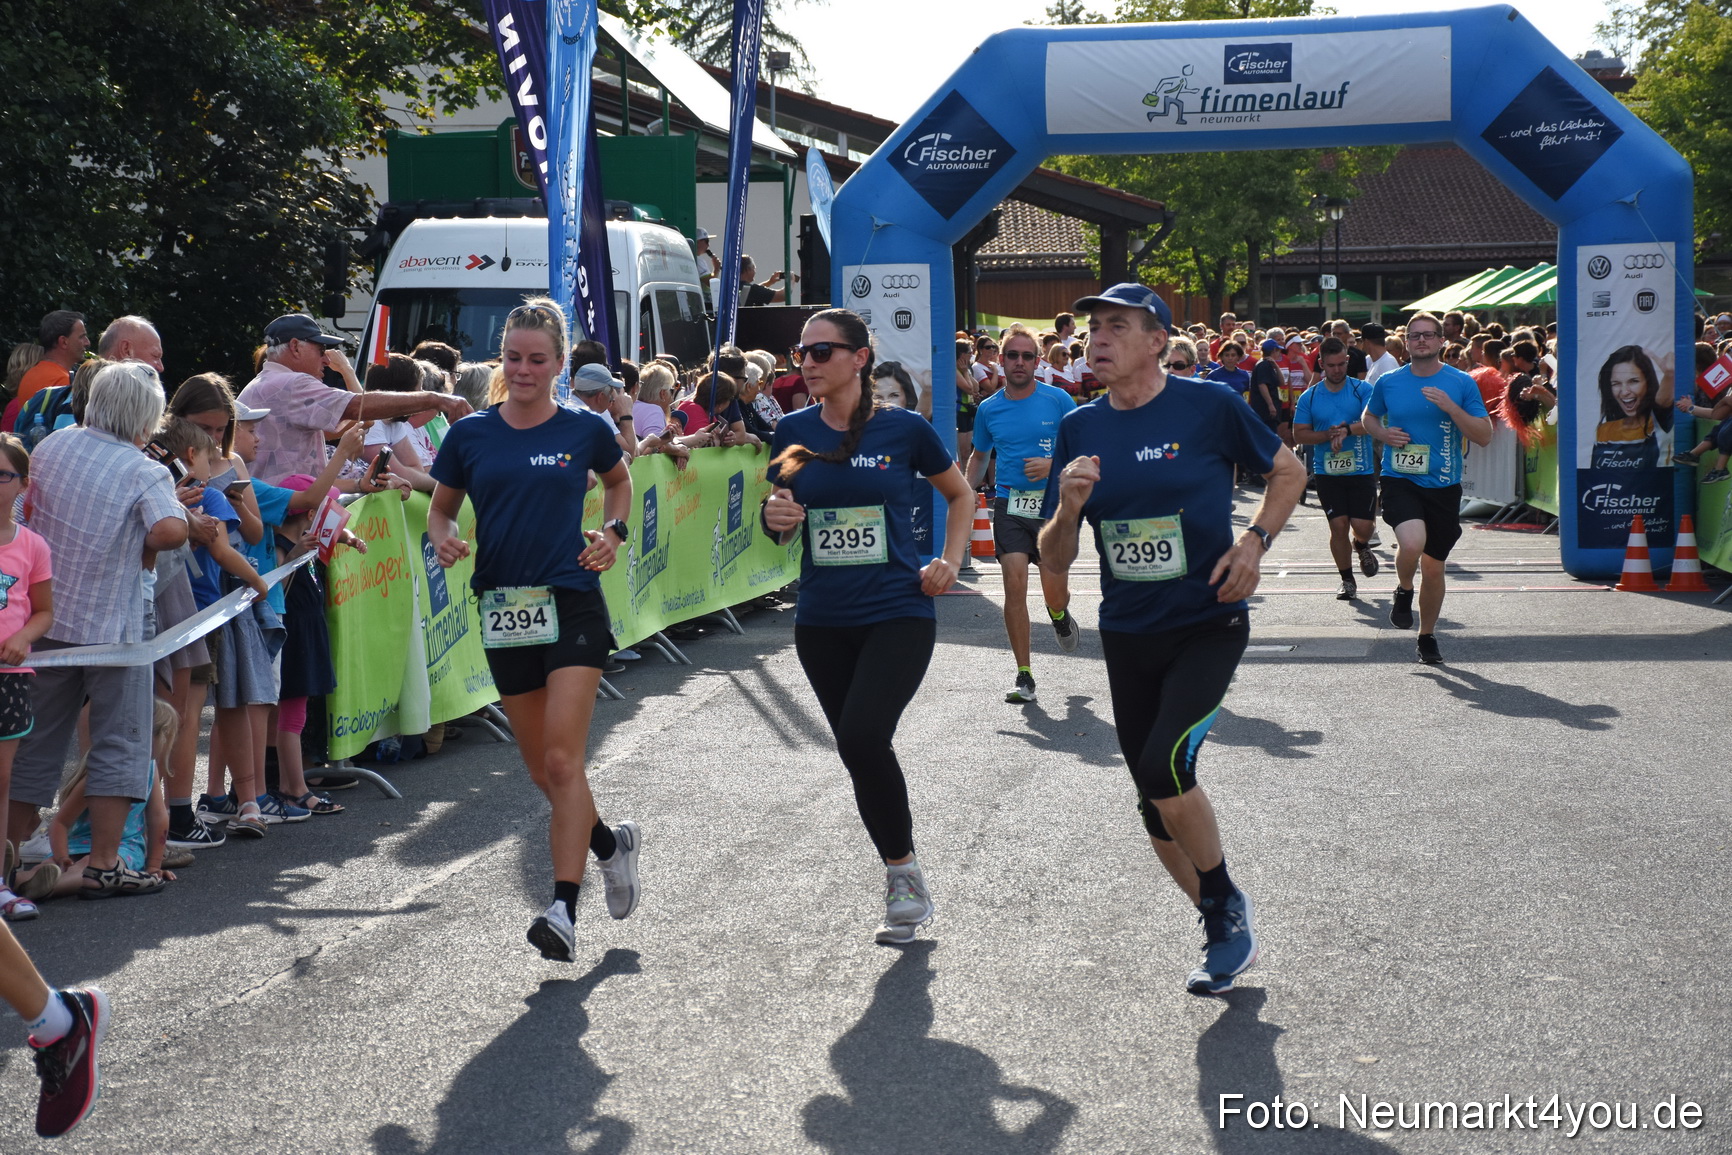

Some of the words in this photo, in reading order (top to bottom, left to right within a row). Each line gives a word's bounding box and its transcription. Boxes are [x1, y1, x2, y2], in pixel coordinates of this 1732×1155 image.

[1239, 58, 1288, 71] Fischer
[1200, 80, 1350, 114] firmenlauf
[1200, 113, 1261, 124] neumarkt
[919, 145, 996, 162] Fischer
[925, 161, 990, 171] AUTOMOBILE
[398, 255, 462, 269] abavent
[1639, 295, 1654, 308] FIAT
[896, 313, 911, 326] FIAT
[529, 453, 556, 466] vhs
[850, 453, 877, 468] vhs
[1135, 445, 1163, 462] vhs
[1394, 453, 1424, 467] 1734
[1327, 458, 1352, 469] 1726
[1594, 494, 1661, 508] Fischer
[1600, 507, 1656, 515] AUTOMOBILE
[818, 527, 876, 550] 2395
[1112, 540, 1172, 564] 2399
[489, 607, 547, 631] 2394
